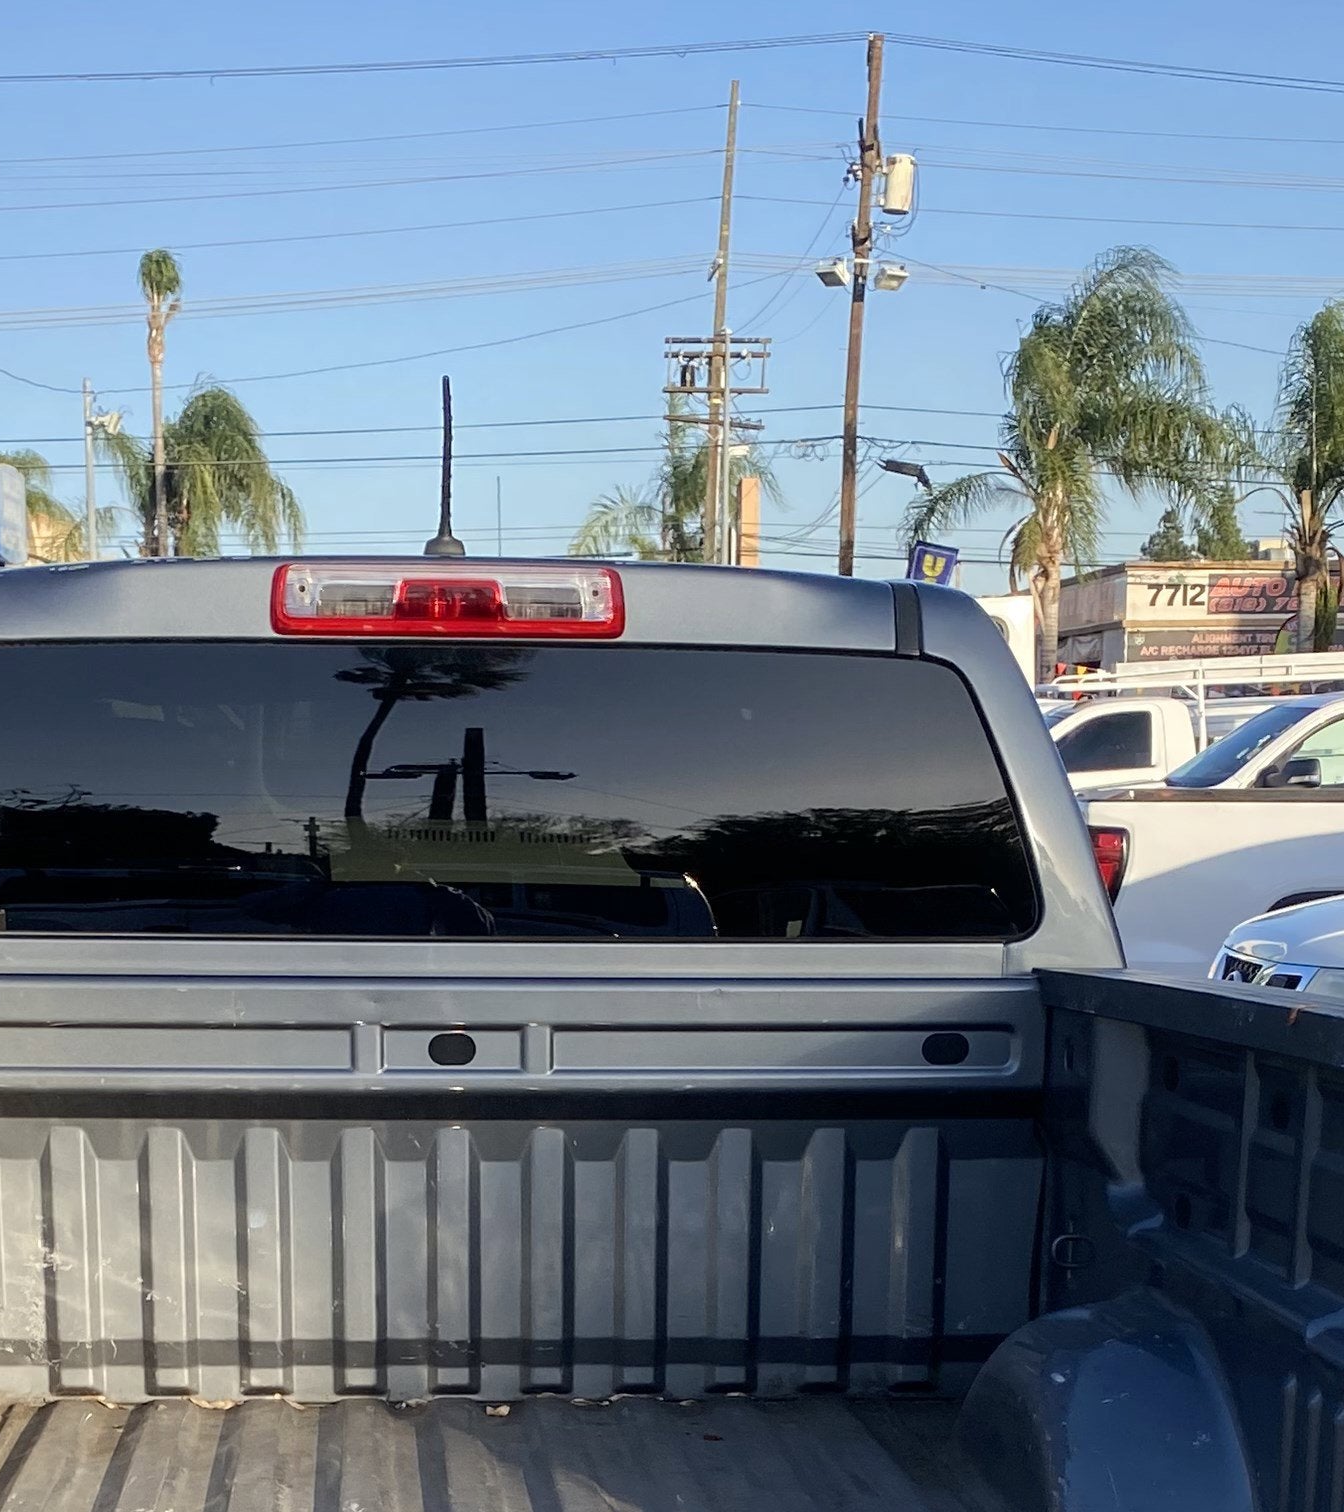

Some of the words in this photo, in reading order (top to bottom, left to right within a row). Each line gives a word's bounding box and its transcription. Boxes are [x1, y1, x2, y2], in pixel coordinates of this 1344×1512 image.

[1209, 576, 1287, 597] AUTO
[1147, 583, 1205, 607] 7712
[1191, 633, 1253, 644] ALIGNMENT
[1161, 644, 1220, 656] RECHARGE
